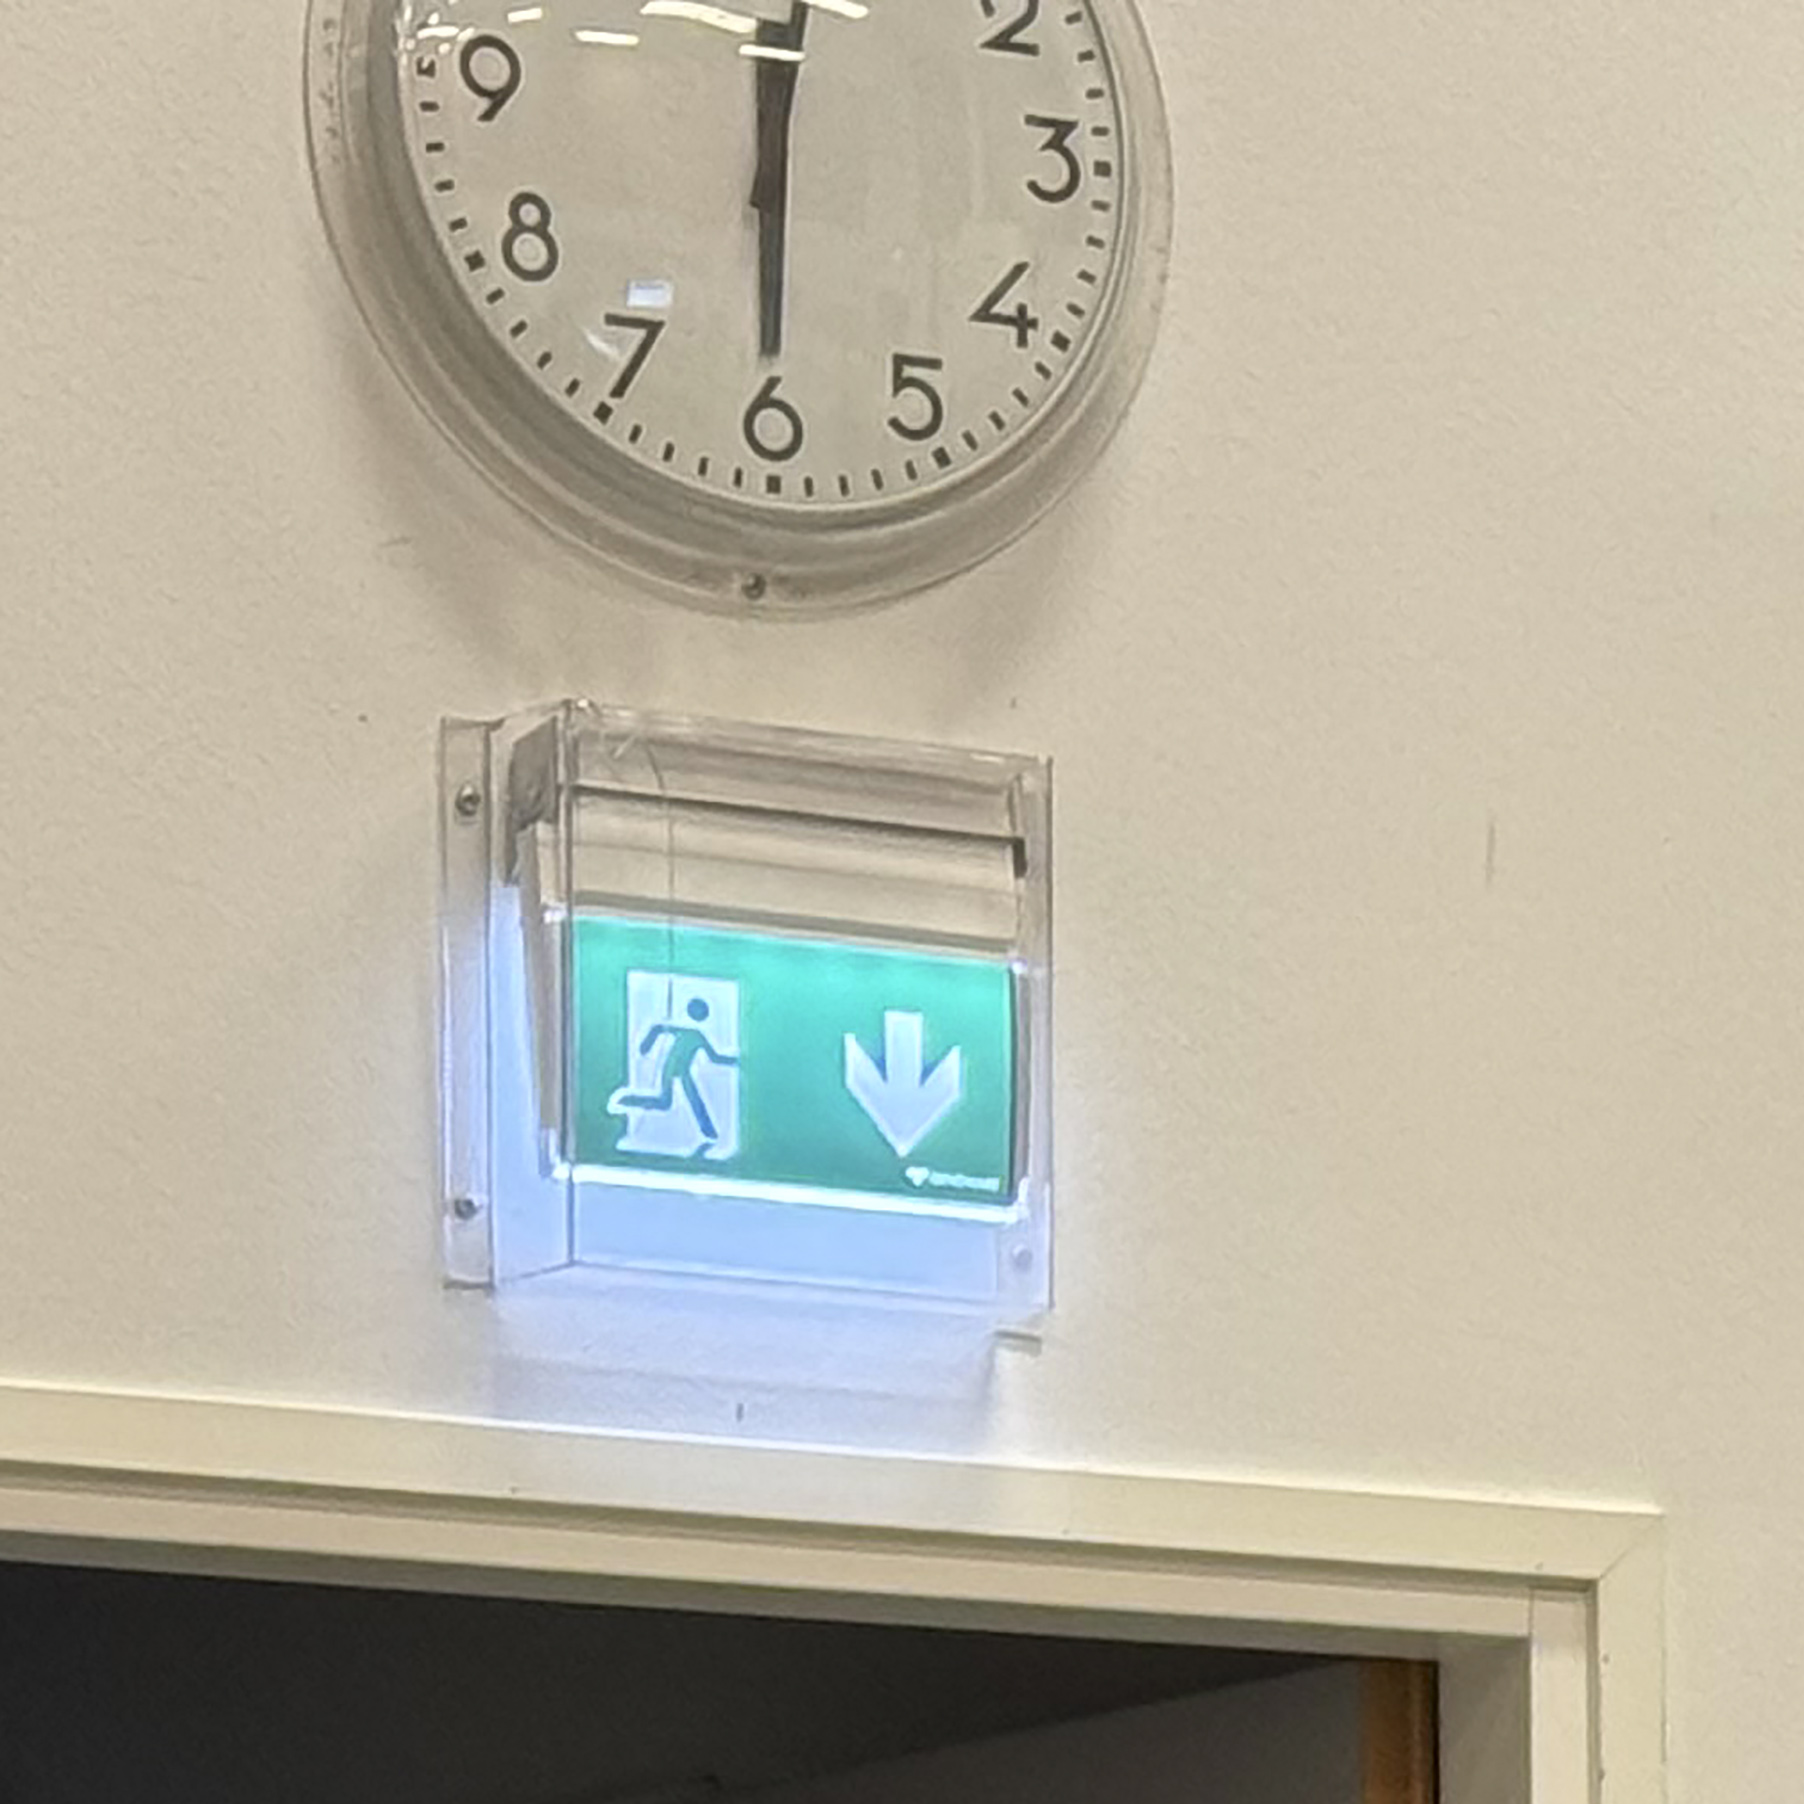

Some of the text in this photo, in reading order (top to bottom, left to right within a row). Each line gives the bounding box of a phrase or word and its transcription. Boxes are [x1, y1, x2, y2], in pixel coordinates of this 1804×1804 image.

[980, 0, 1041, 56] 2
[459, 34, 522, 122] 9
[1023, 114, 1080, 203] 3
[501, 191, 559, 282] 8
[968, 262, 1040, 349] 4
[603, 313, 666, 398] 7
[887, 353, 944, 442] 5
[743, 376, 803, 462] 6
